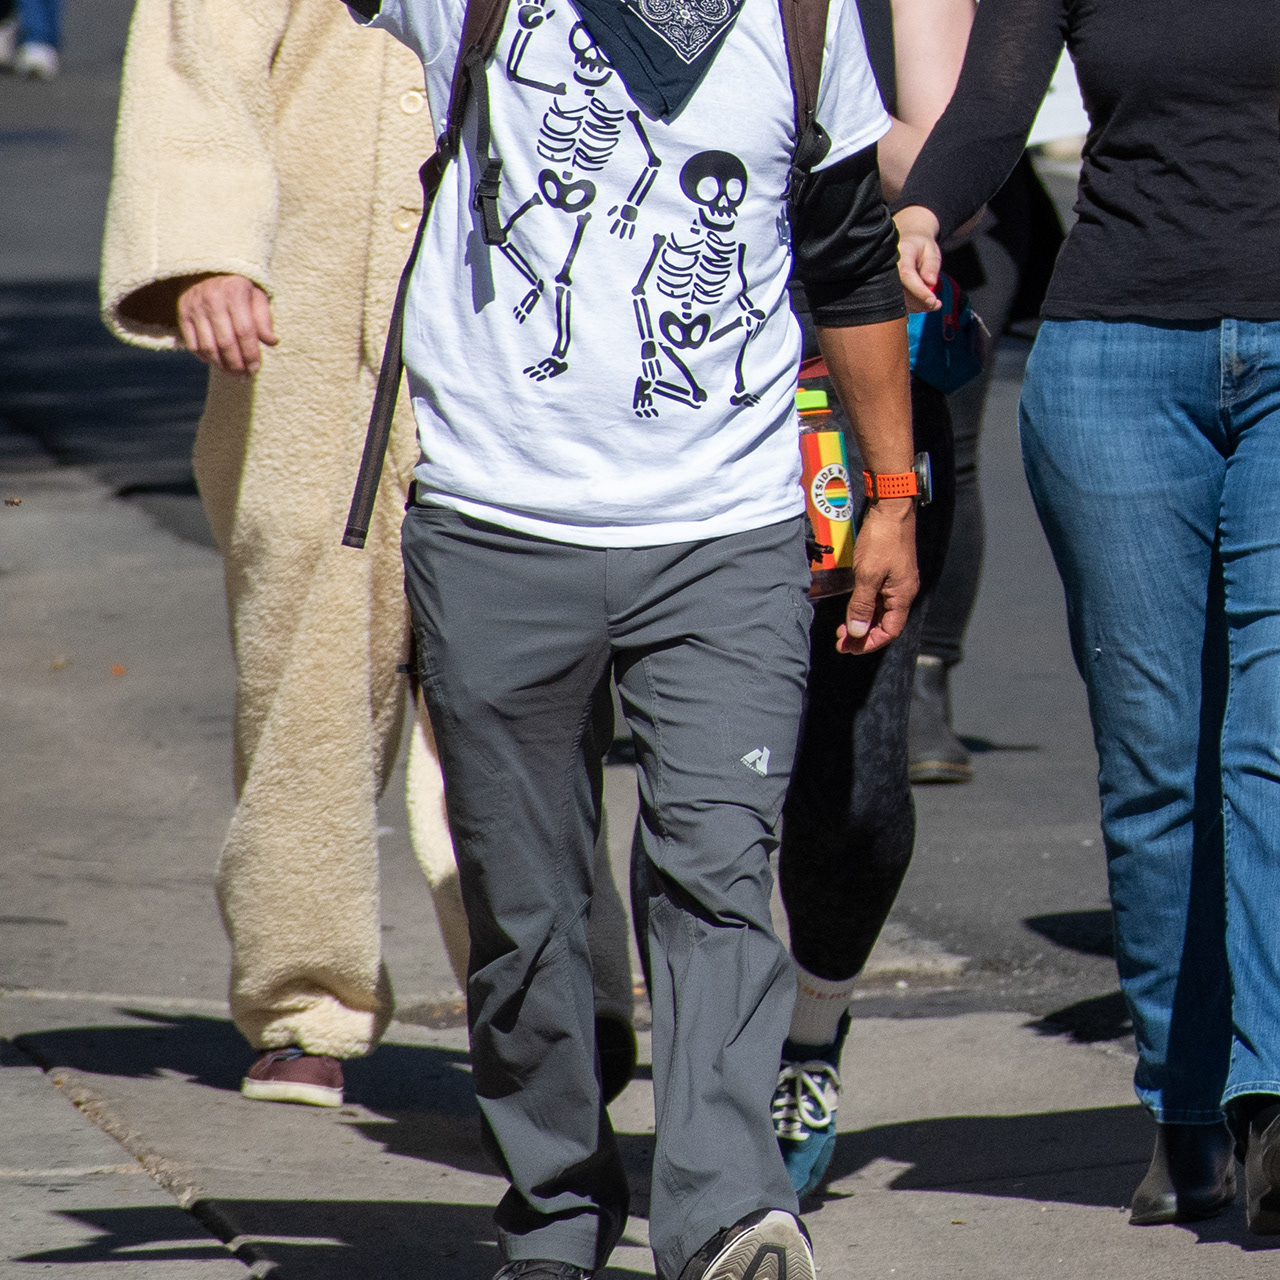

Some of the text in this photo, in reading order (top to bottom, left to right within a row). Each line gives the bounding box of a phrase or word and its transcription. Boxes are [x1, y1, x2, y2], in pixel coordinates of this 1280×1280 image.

[537, 96, 589, 163] FUCK
[572, 97, 624, 172] TRUMP
[656, 232, 705, 299] FUCK
[690, 230, 737, 305] TRUMP
[814, 467, 835, 514] OUTSIDE
